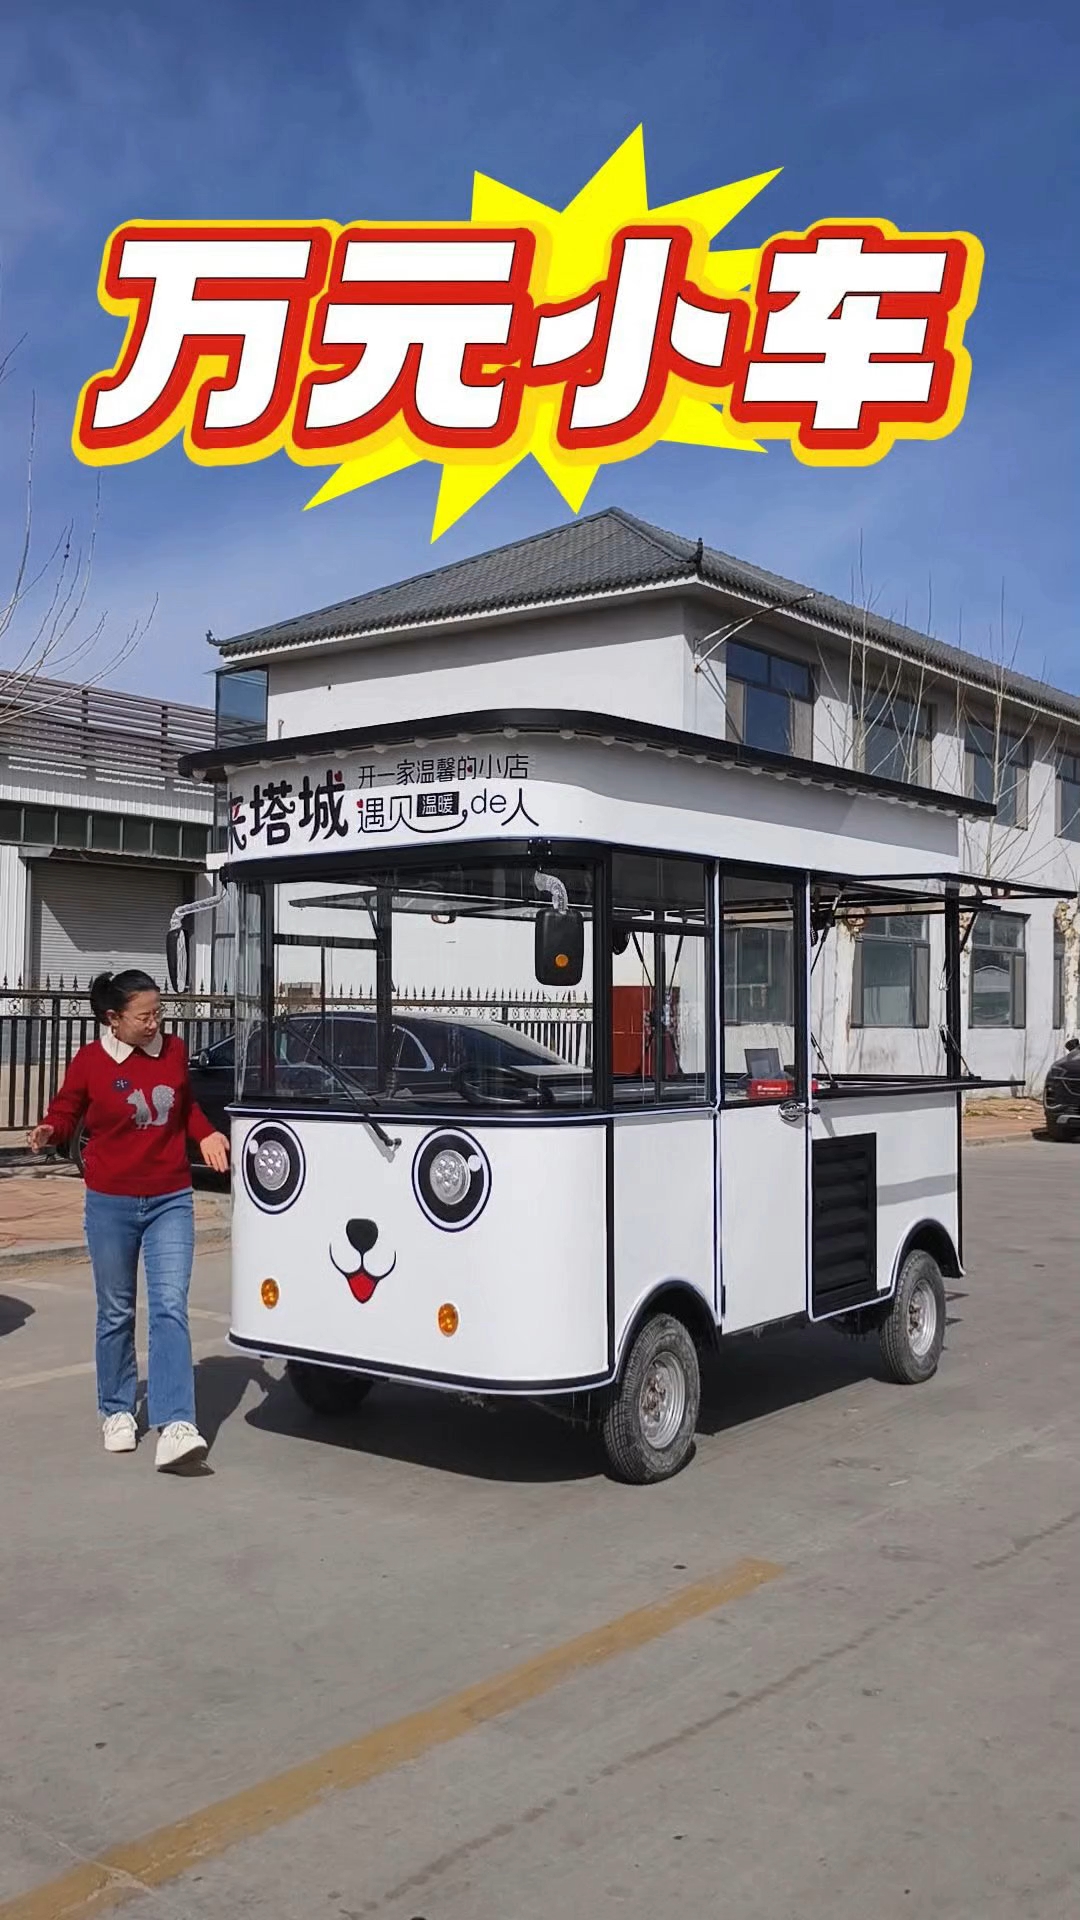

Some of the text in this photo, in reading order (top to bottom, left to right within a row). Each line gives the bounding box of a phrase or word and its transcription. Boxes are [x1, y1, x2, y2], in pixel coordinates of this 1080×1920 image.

[357, 753, 530, 789] 开一家温馨的小店
